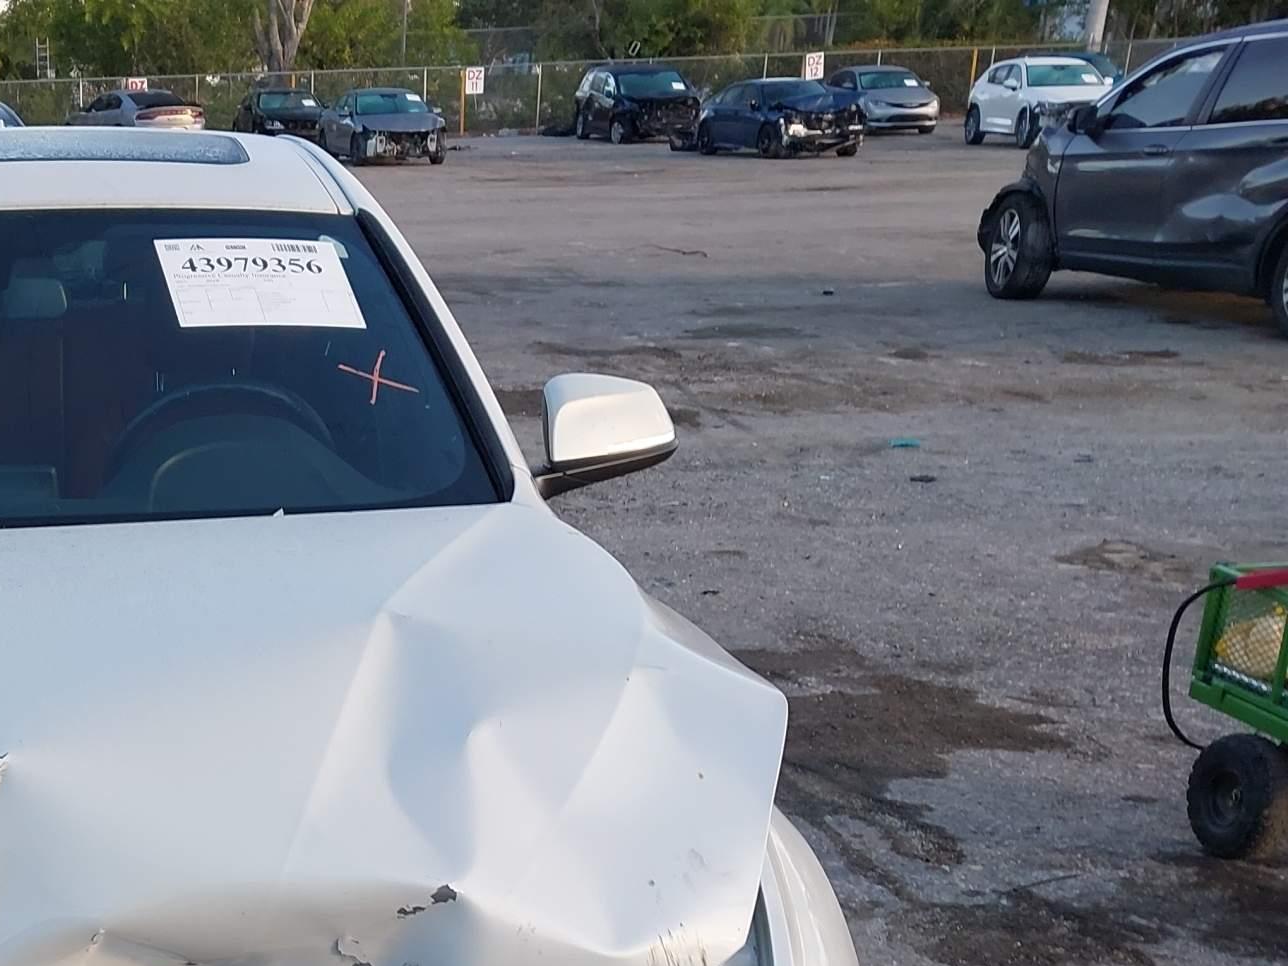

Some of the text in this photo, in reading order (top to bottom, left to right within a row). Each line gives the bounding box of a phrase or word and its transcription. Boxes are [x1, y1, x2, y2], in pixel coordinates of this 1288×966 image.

[808, 56, 822, 66] DZ
[468, 70, 483, 80] DZ
[810, 67, 819, 78] 12
[181, 256, 323, 274] 43979356
